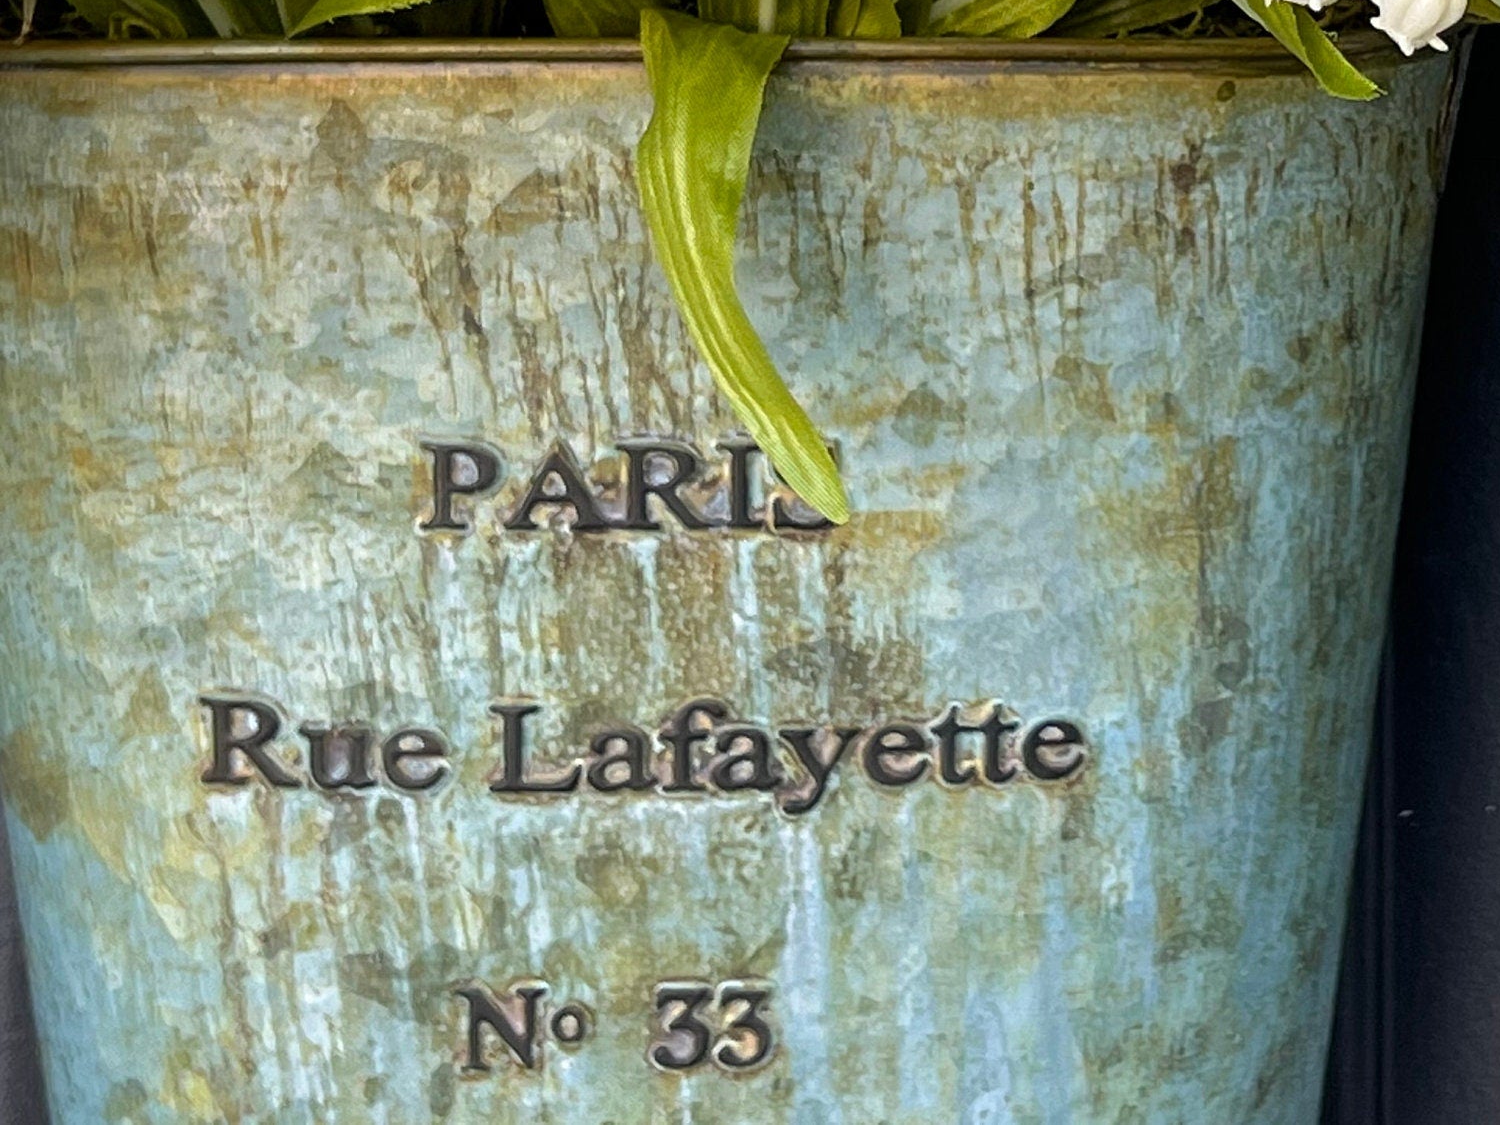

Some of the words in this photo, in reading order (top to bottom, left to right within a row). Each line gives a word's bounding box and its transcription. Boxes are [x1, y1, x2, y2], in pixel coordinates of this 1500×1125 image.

[200, 696, 448, 789] Rue
[488, 695, 1085, 815] Lafayette
[653, 983, 775, 1070] 33
